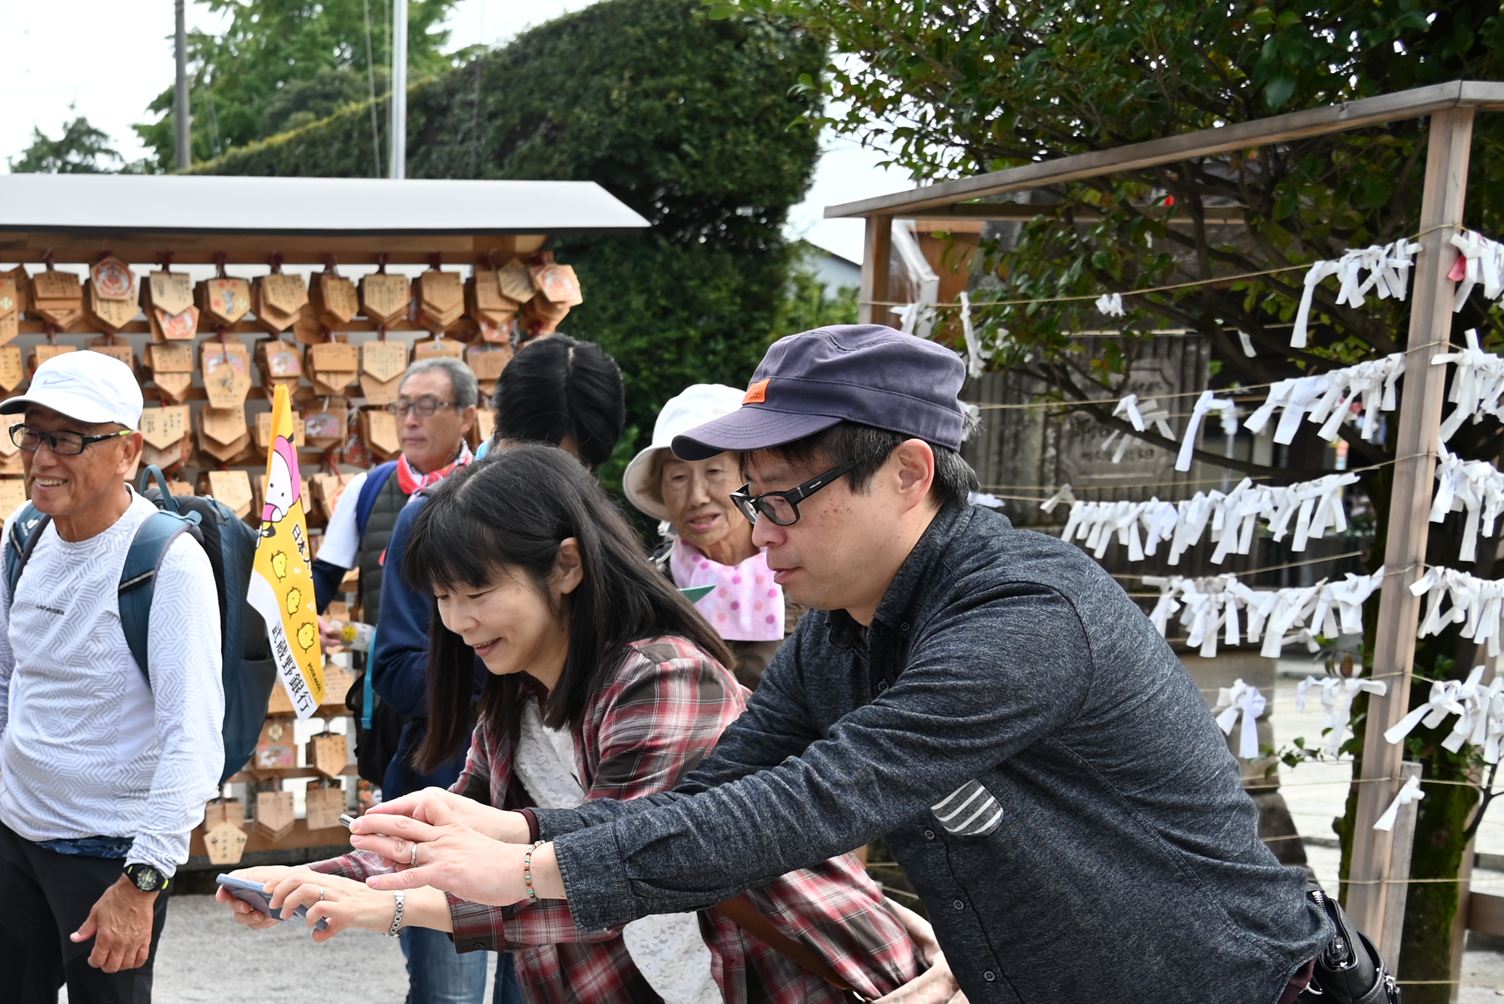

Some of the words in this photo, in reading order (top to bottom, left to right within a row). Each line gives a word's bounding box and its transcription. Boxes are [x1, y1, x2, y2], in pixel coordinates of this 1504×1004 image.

[271, 625, 313, 711] 武蔵野銀行
